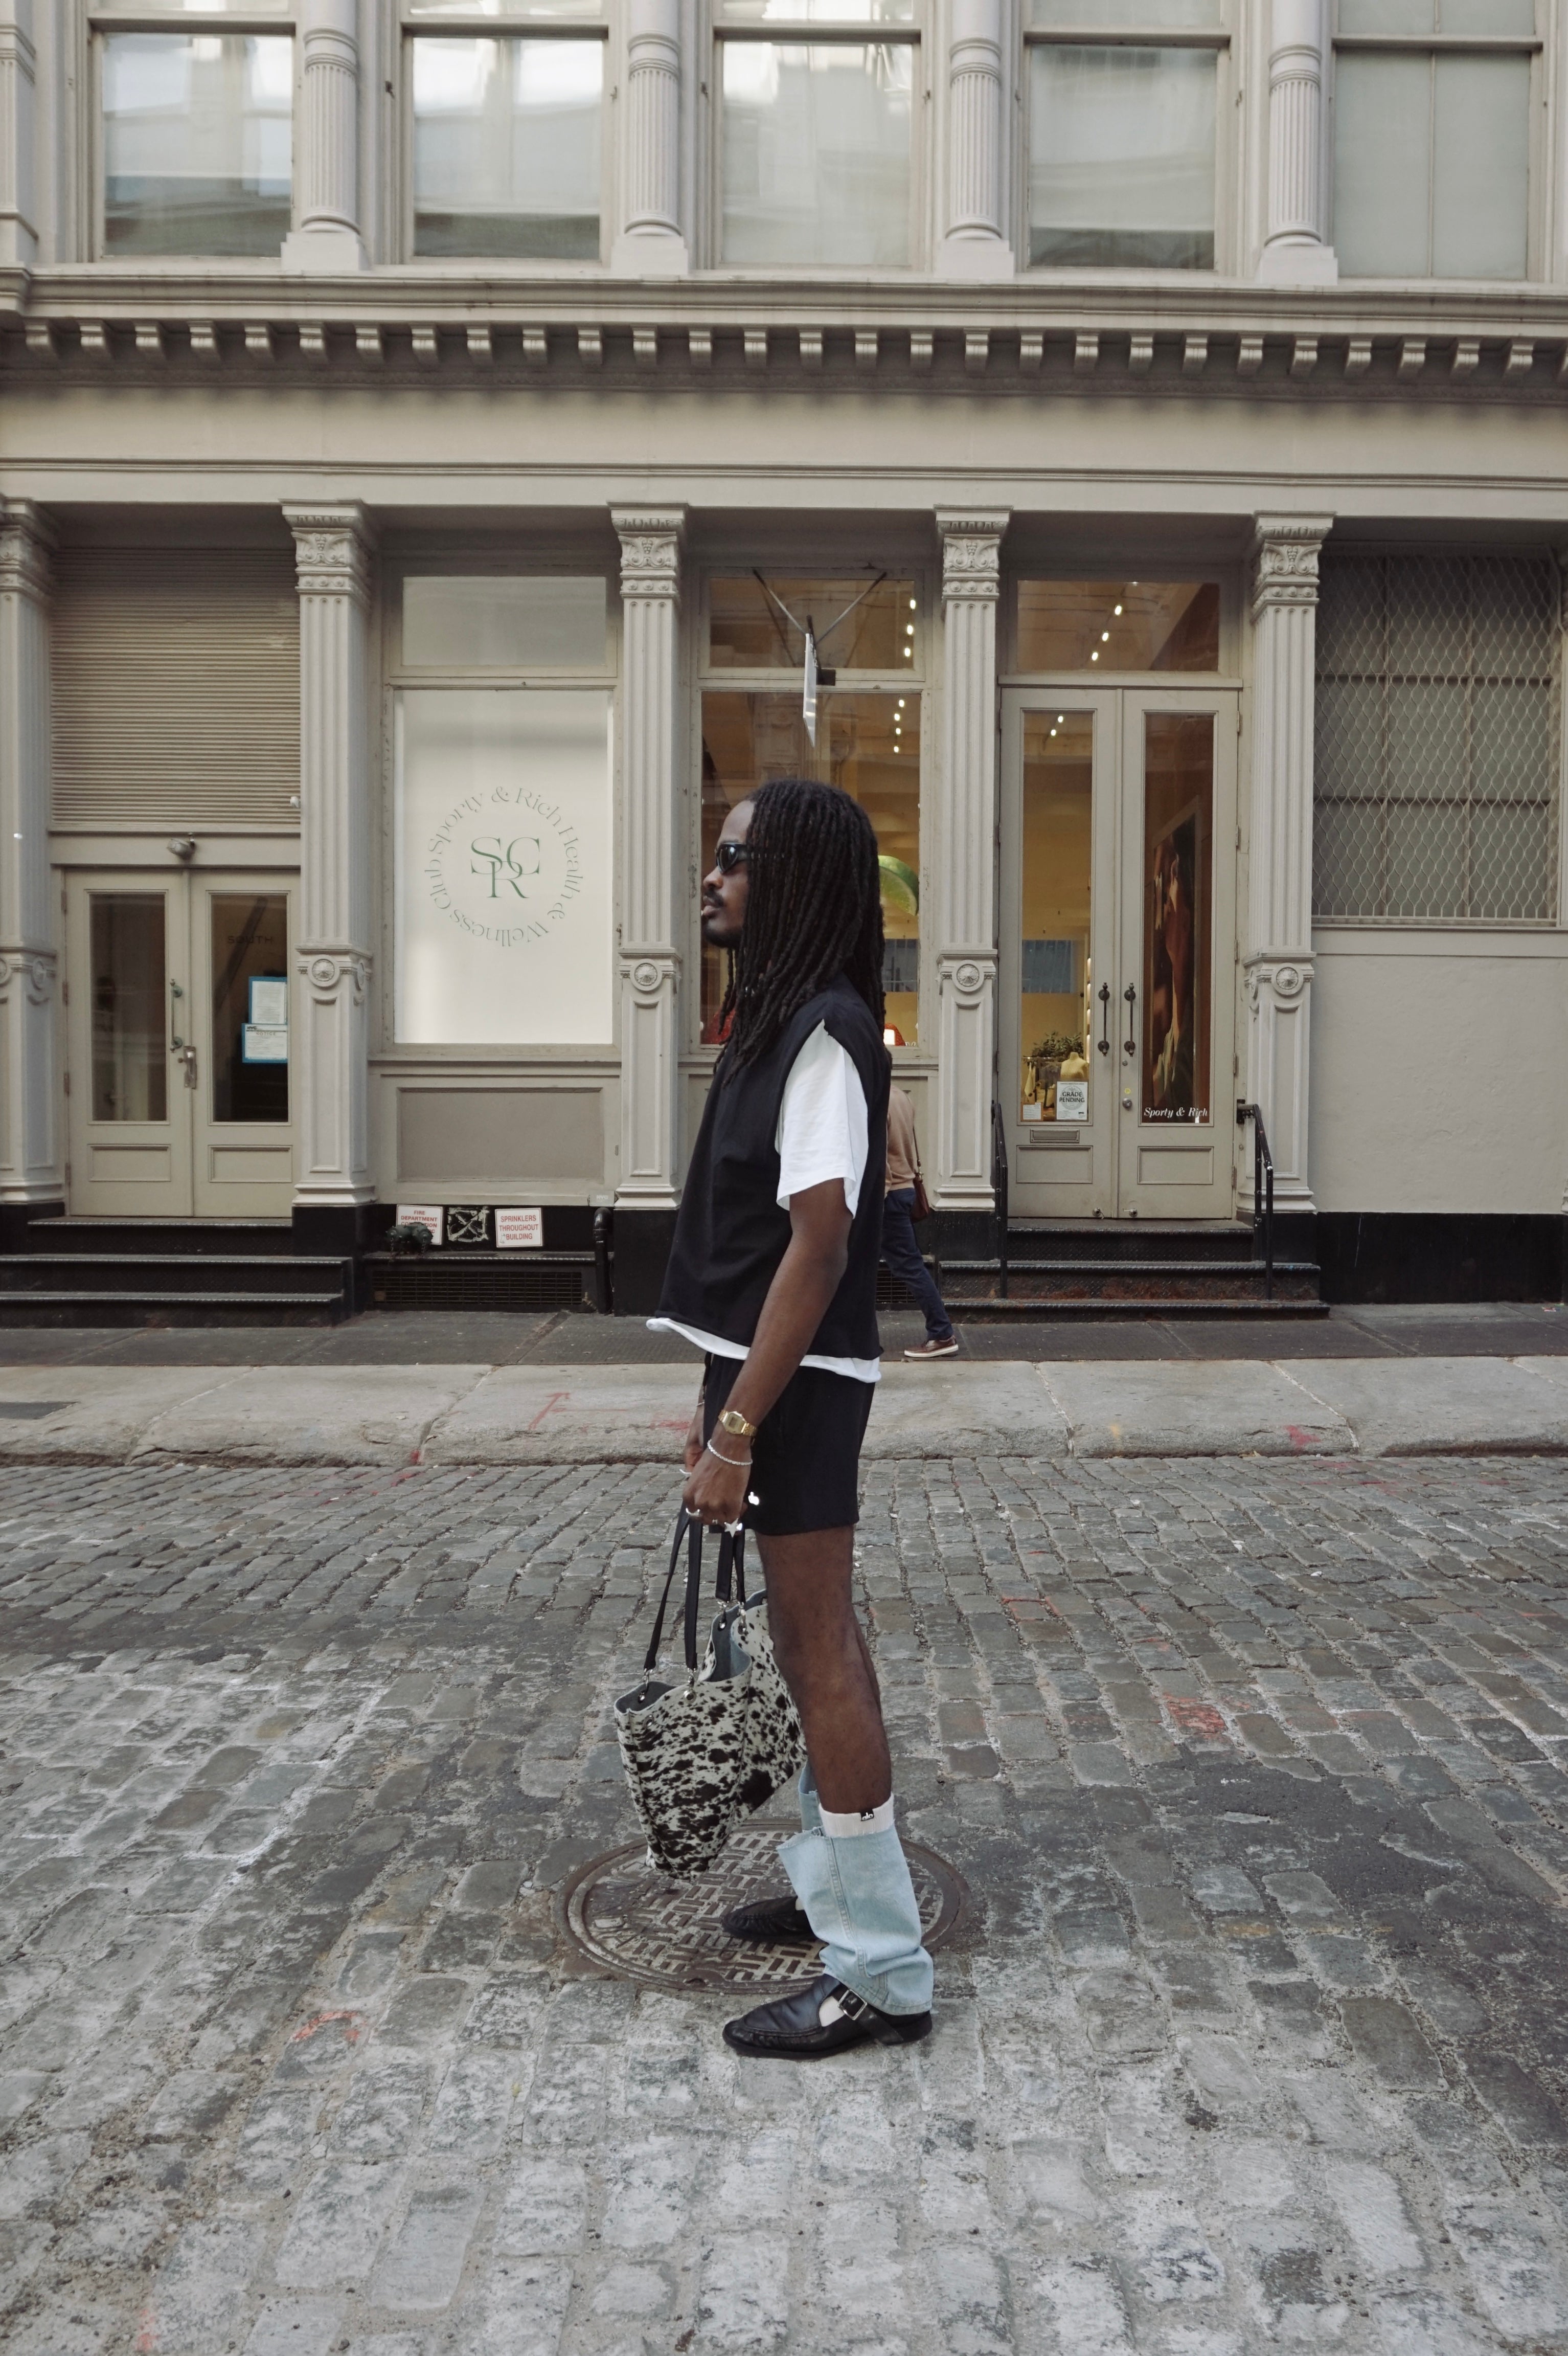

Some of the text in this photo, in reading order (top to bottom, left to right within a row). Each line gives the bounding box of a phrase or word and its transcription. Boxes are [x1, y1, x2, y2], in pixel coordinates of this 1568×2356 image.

[424, 786, 583, 947] Sporty & Rich Health & Wellness Club
[1144, 1107, 1208, 1118] Sporty & Rich
